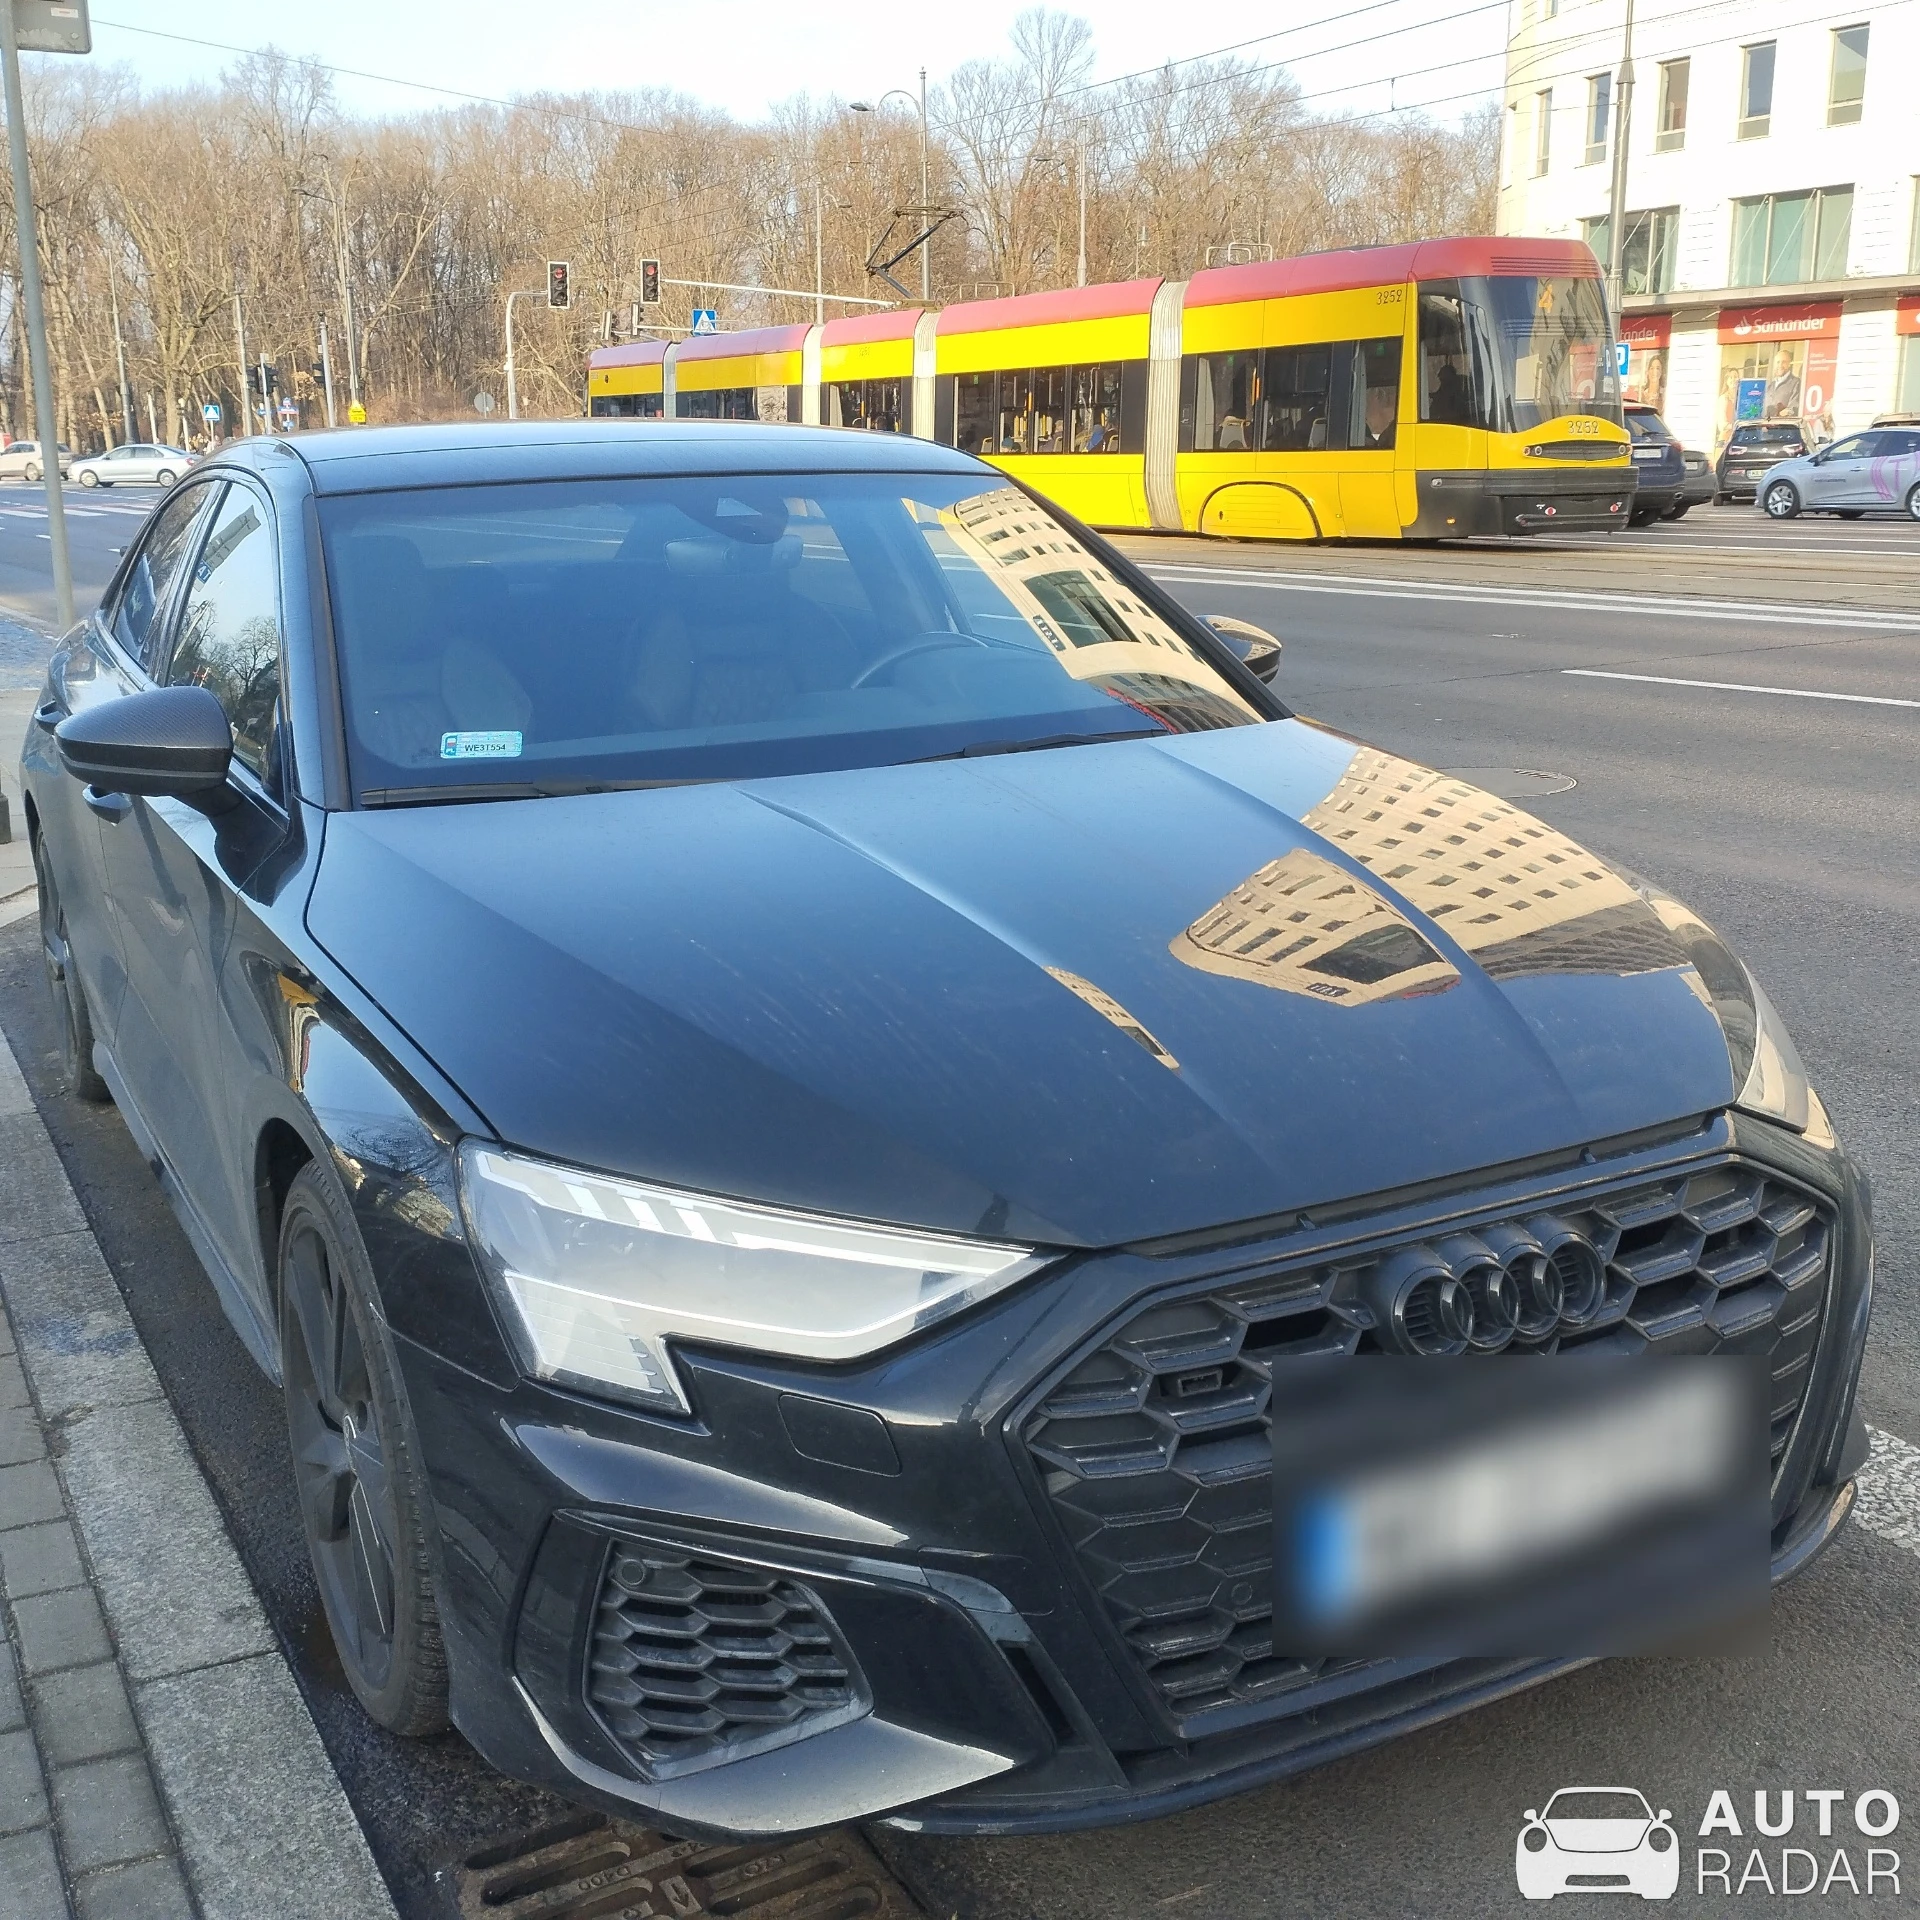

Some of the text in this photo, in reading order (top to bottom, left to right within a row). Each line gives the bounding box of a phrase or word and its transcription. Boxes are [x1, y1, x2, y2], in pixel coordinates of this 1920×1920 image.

[1376, 288, 1403, 305] 3252
[1539, 284, 1553, 313] 4
[1752, 315, 1827, 334] Santander
[1619, 327, 1658, 342] tander
[1805, 385, 1823, 412] 0
[1567, 420, 1599, 434] 3252
[465, 743, 506, 752] WE3T554
